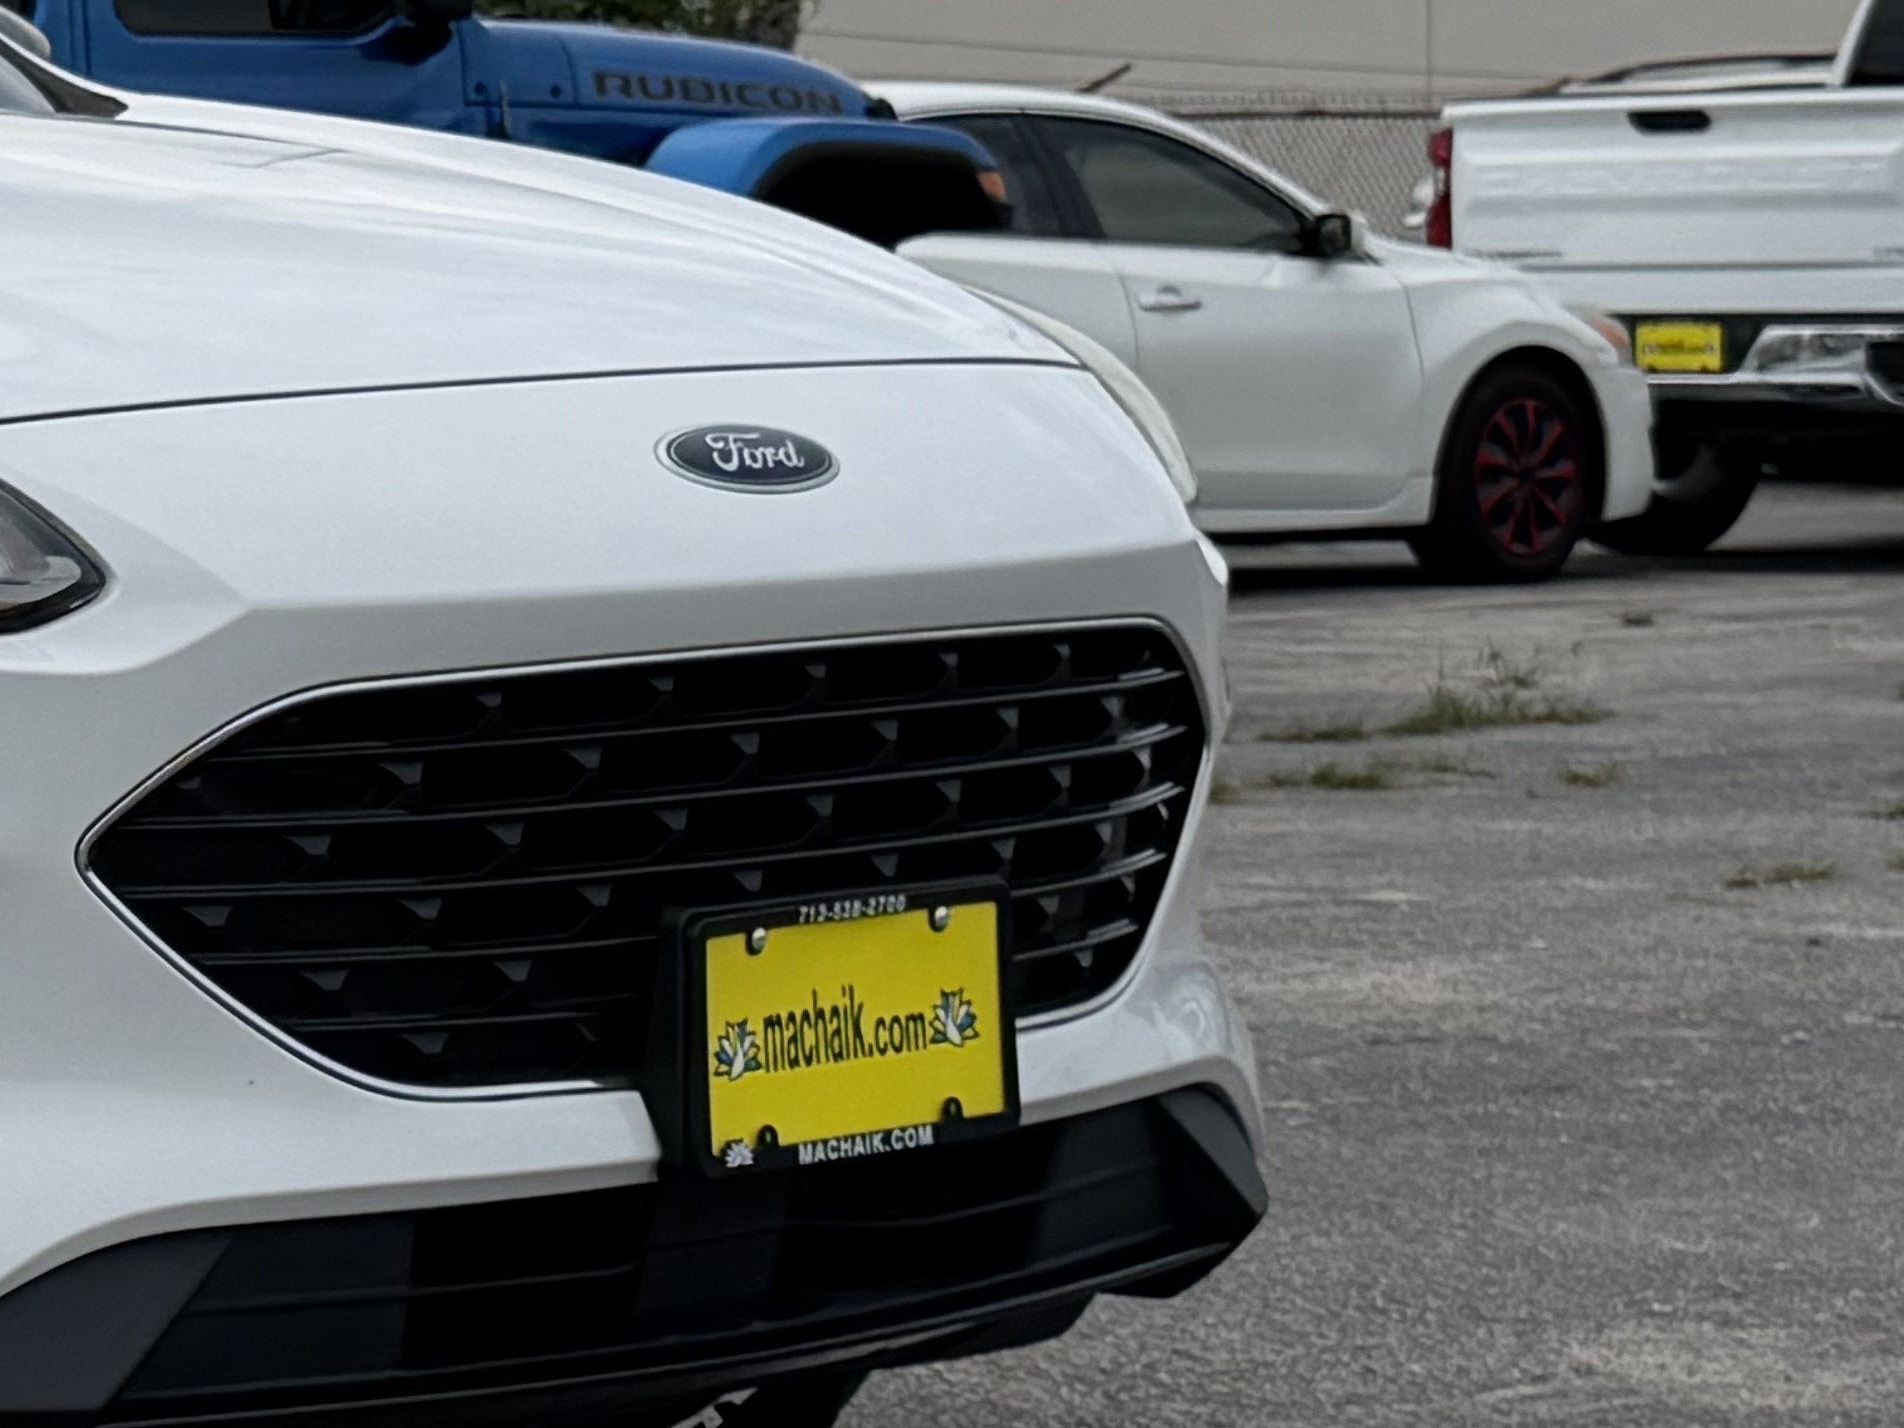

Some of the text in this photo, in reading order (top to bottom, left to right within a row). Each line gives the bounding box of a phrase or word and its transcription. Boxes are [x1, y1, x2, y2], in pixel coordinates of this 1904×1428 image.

[595, 70, 843, 114] RUBICON
[705, 431, 805, 472] Ford
[762, 983, 929, 1073] machaik.com
[798, 1125, 934, 1165] MACHAIK.COM
